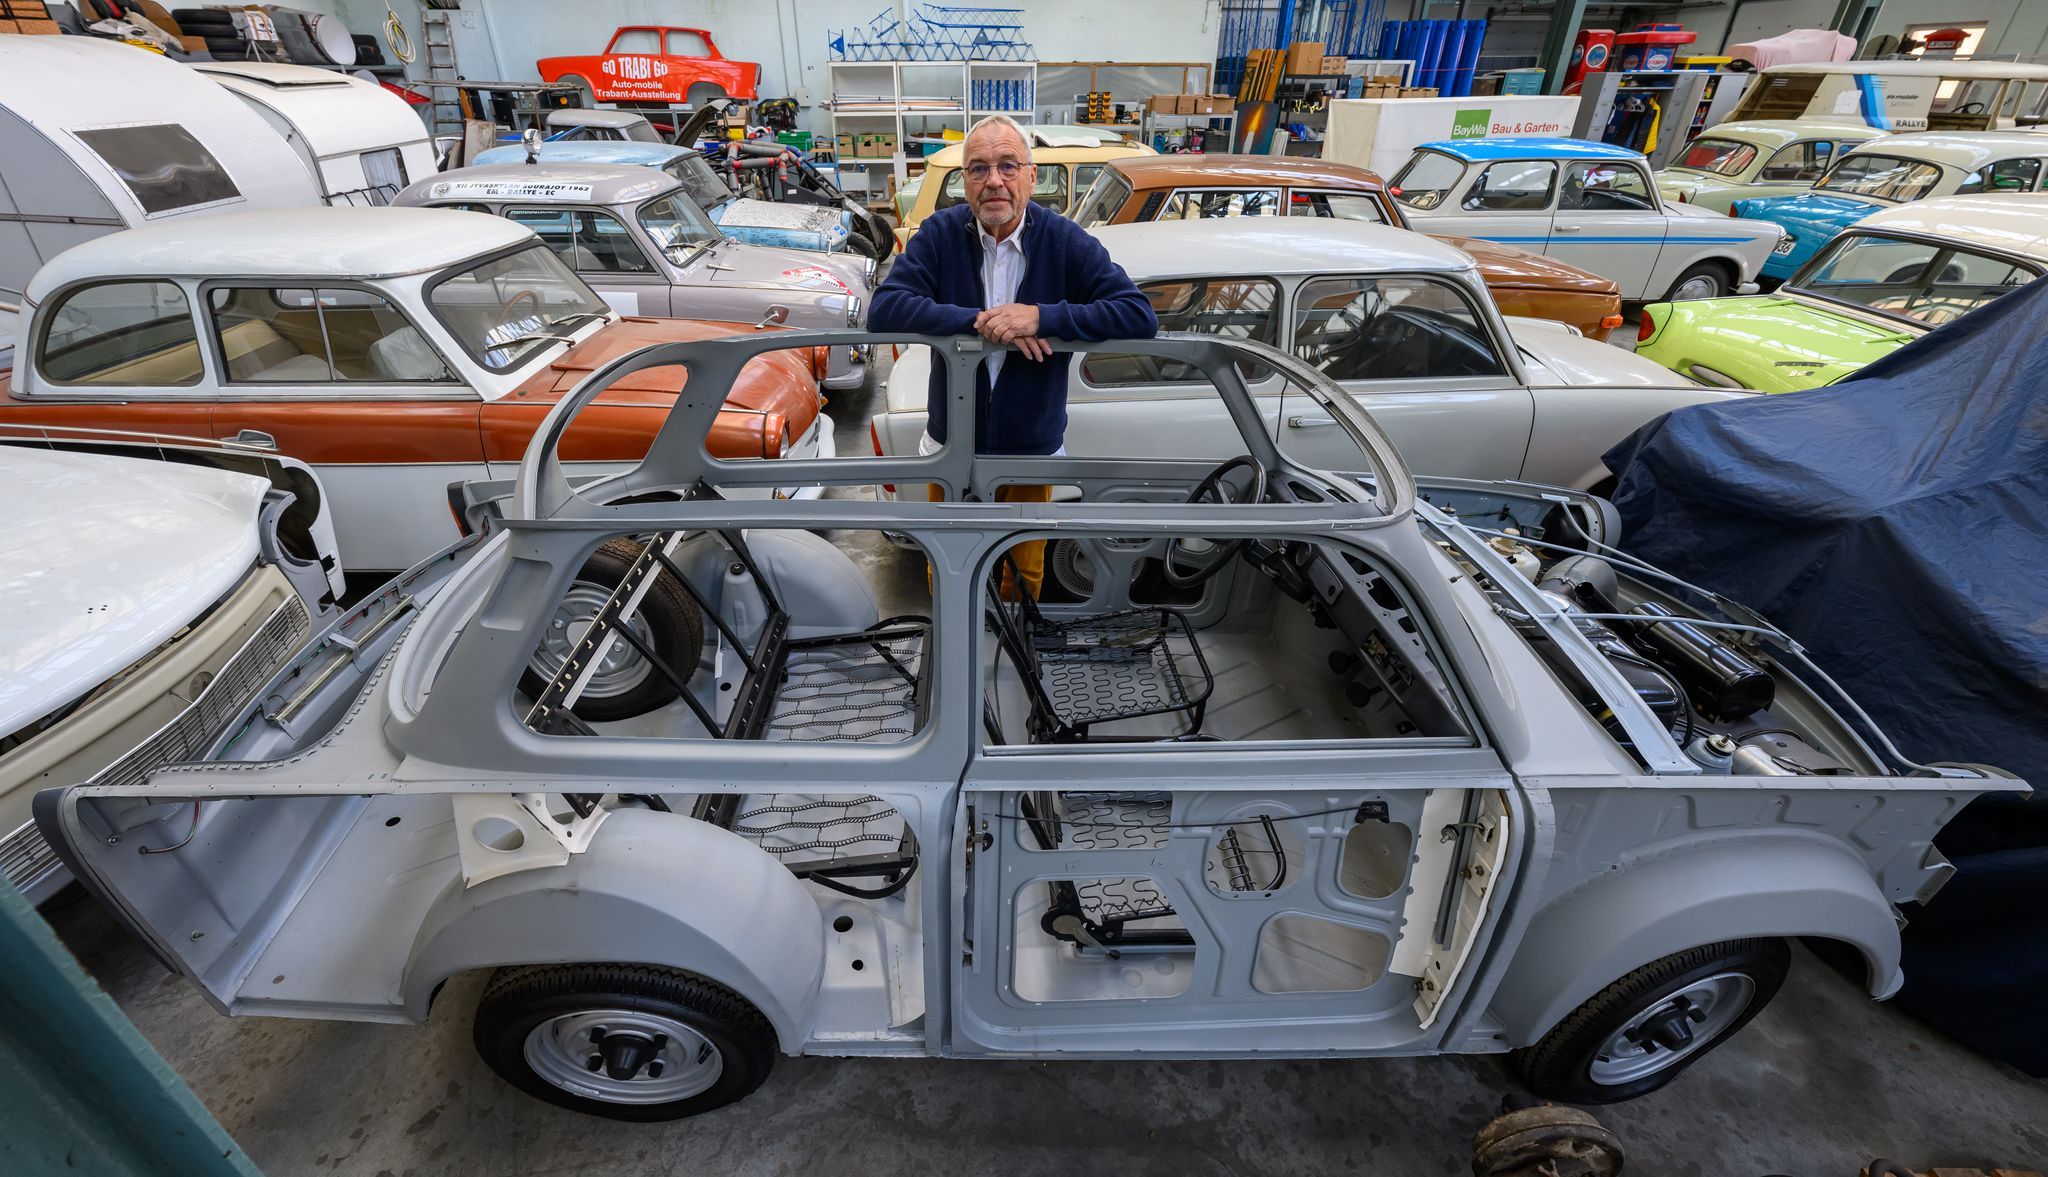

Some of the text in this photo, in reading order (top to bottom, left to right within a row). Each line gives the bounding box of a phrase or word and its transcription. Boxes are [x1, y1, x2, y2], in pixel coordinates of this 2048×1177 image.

[602, 57, 668, 79] GO TRABI GO
[612, 80, 662, 89] Auto-mobile
[597, 89, 680, 100] Trabant-Ausstellung
[1454, 125, 1485, 136] BayWa
[1491, 122, 1559, 134] Bau & Garten
